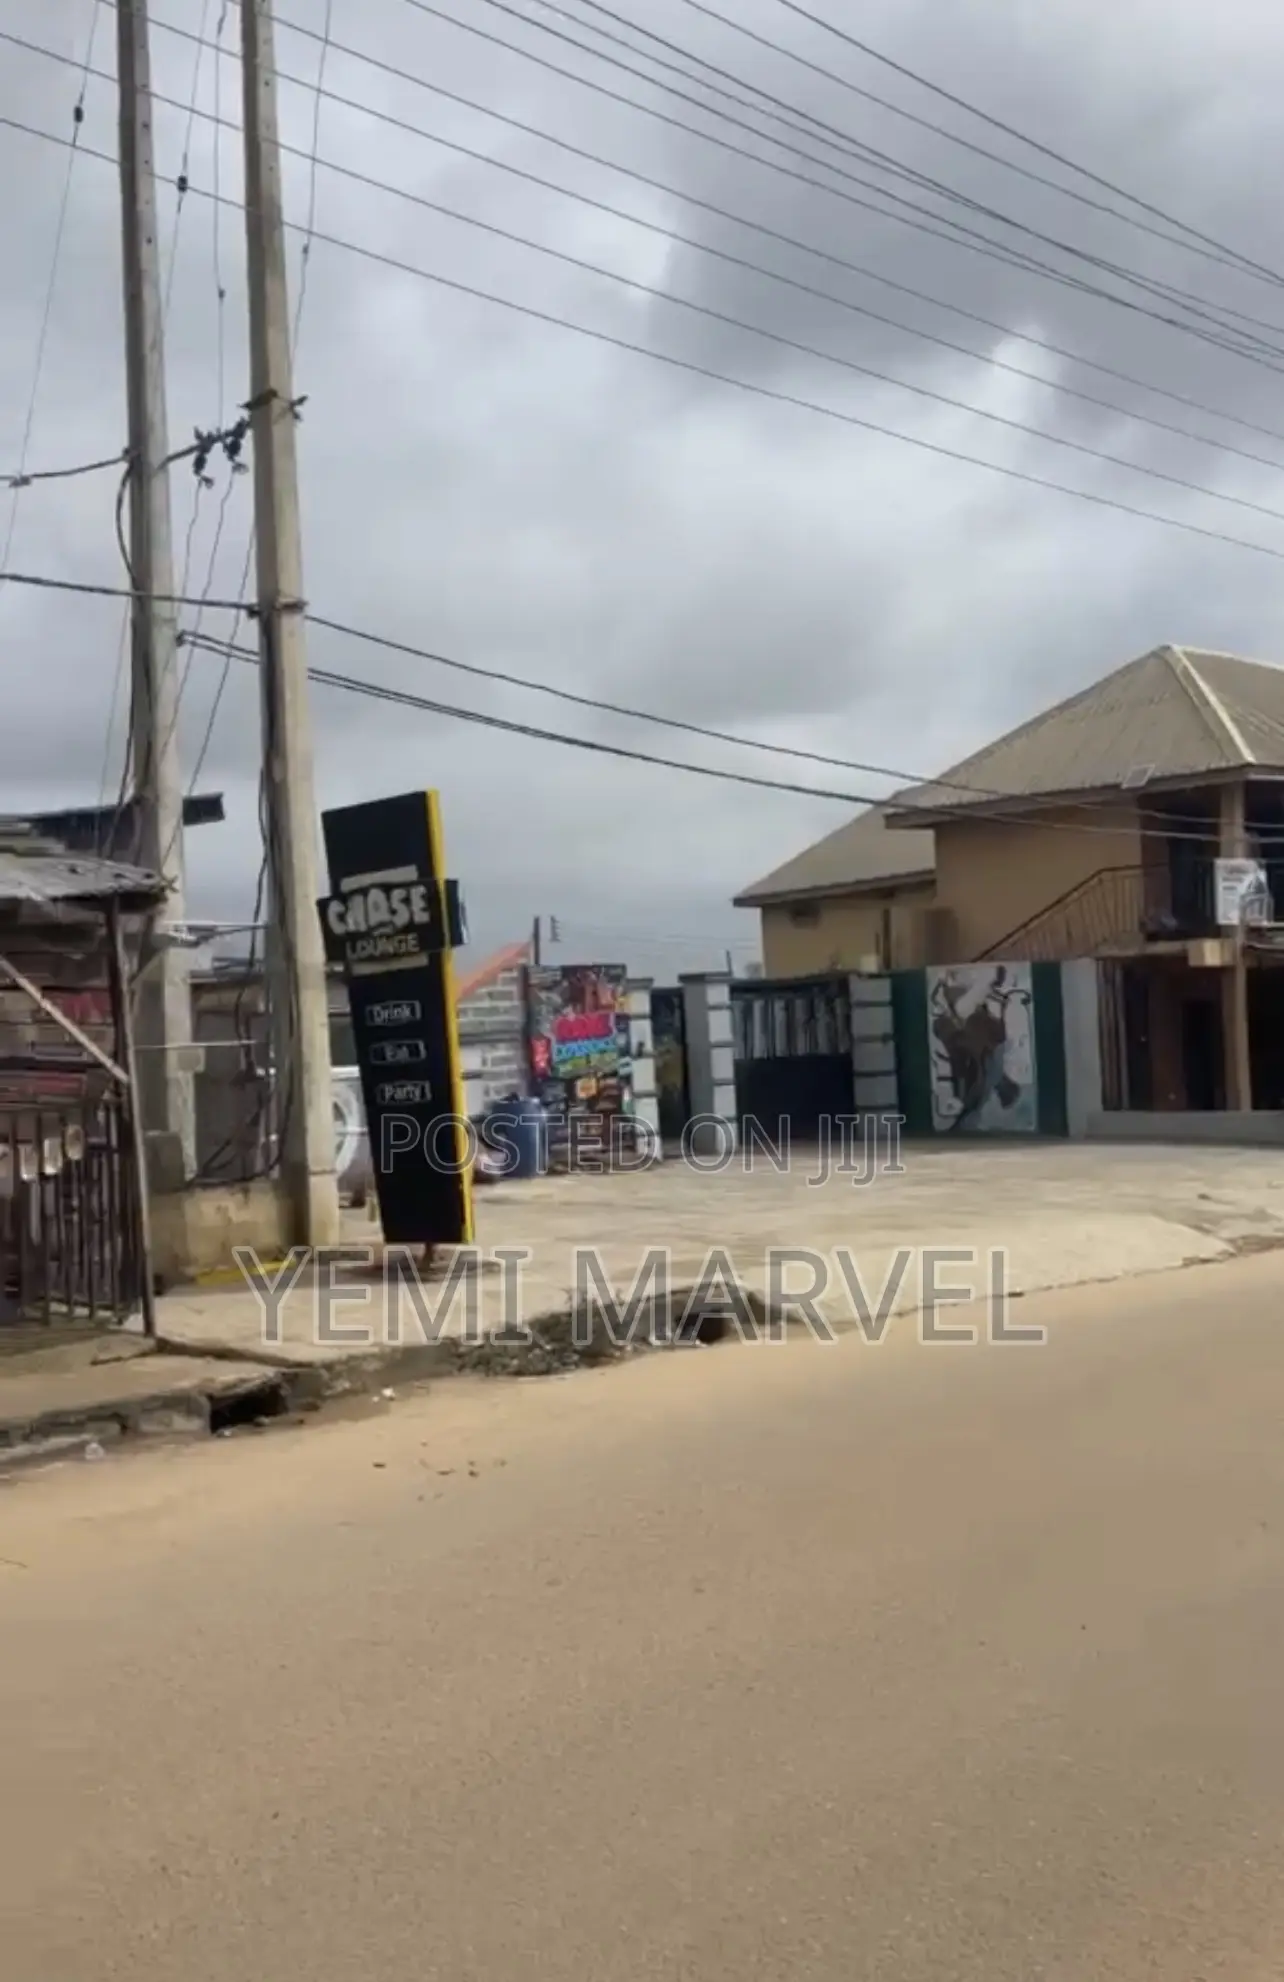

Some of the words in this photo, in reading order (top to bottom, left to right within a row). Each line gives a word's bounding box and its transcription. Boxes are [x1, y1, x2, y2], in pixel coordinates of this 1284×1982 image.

[327, 885, 430, 935] CHASE
[345, 933, 420, 960] LOUNGE
[373, 1003, 411, 1024] Drink
[384, 1084, 421, 1105] Party
